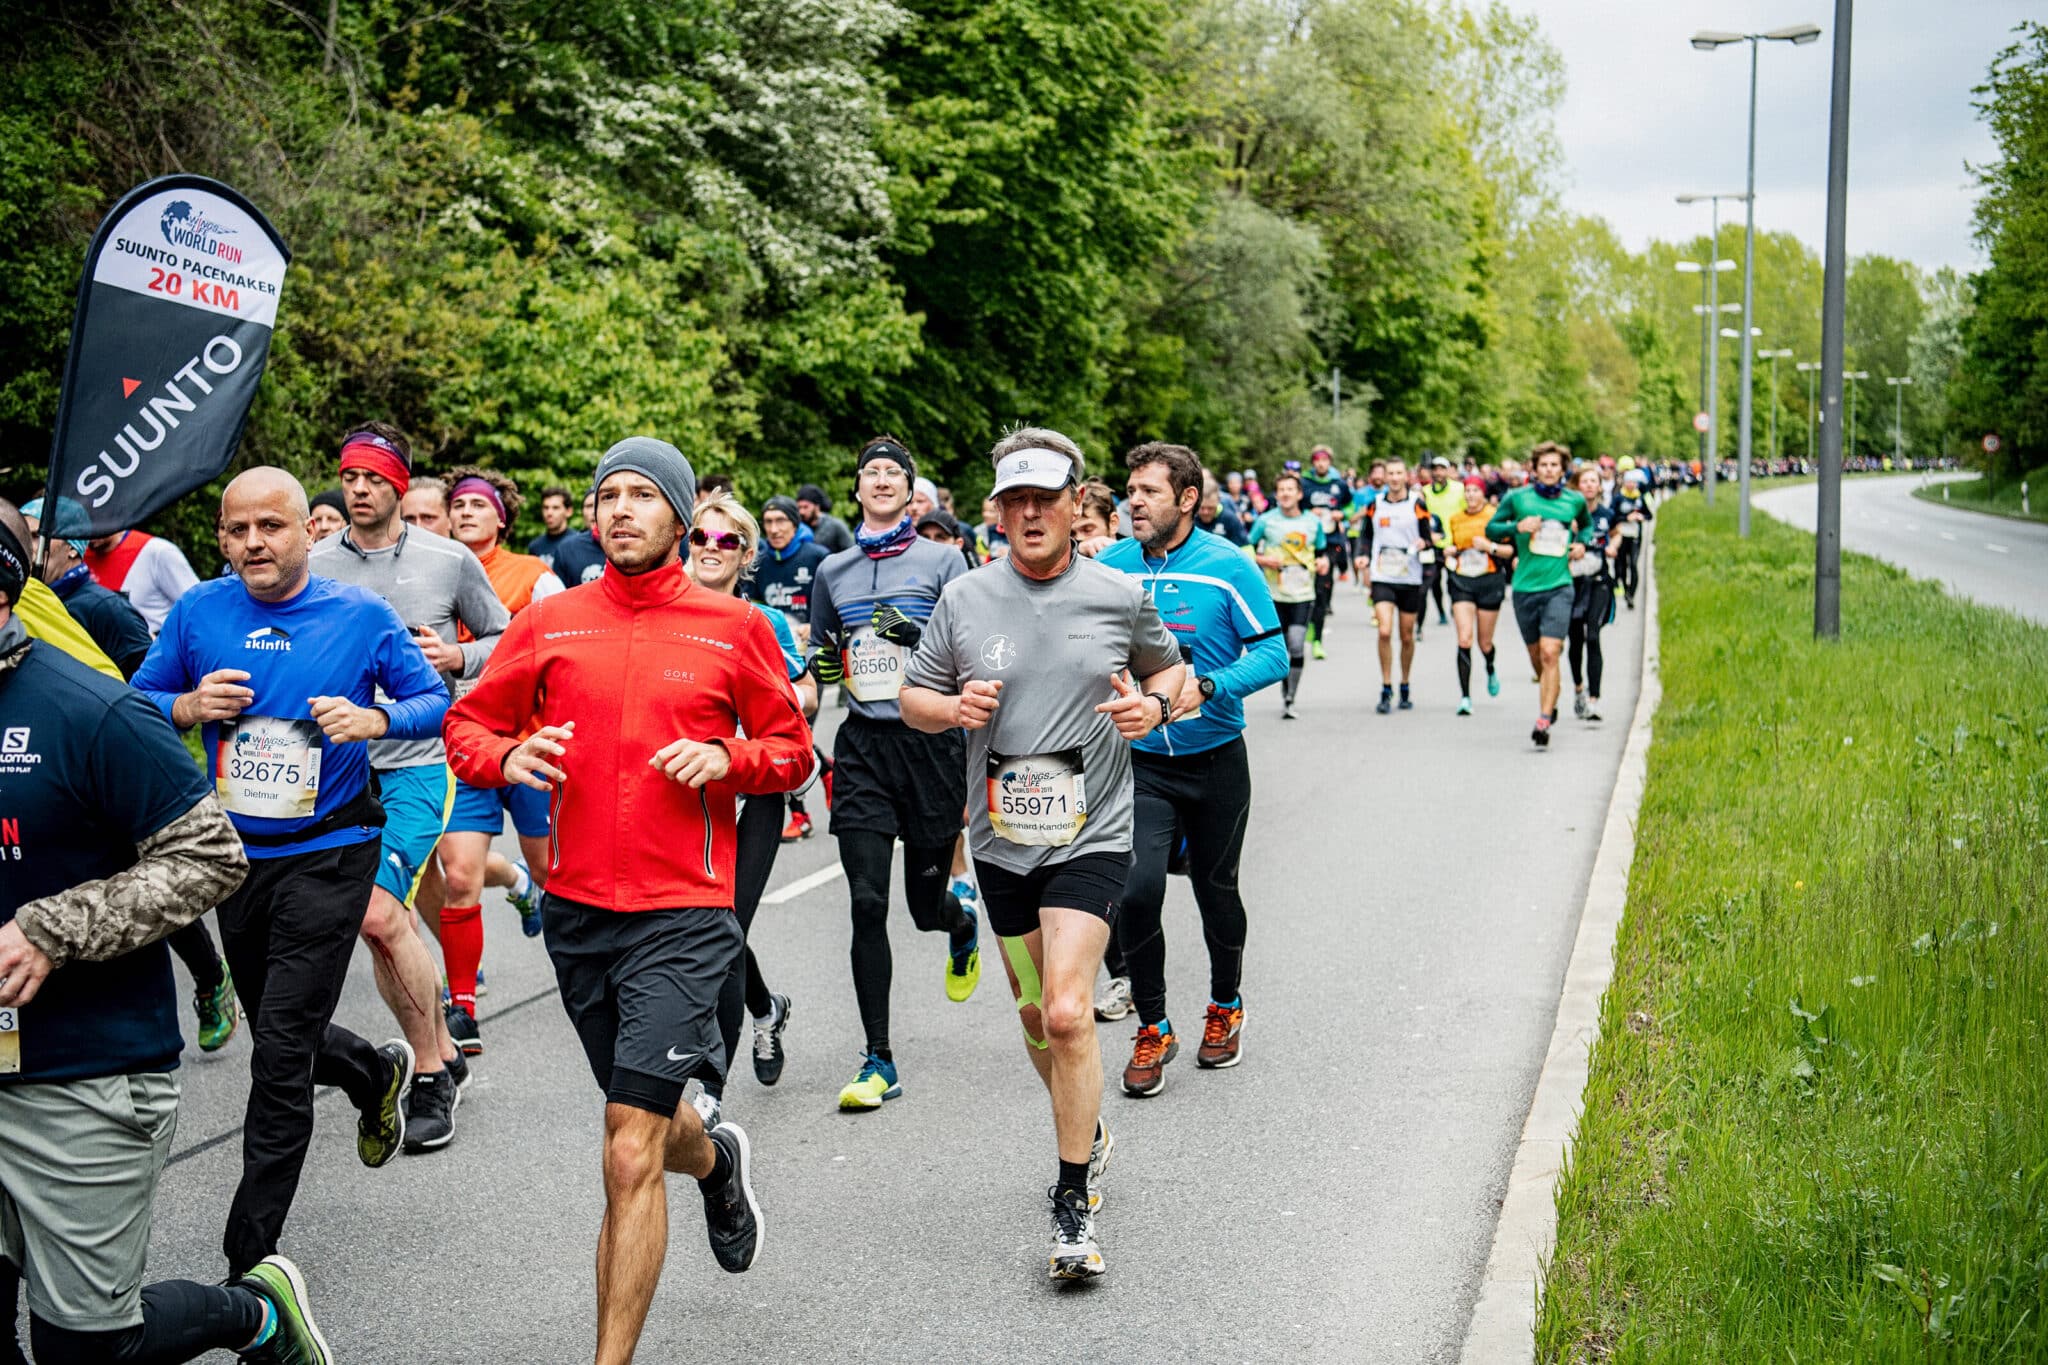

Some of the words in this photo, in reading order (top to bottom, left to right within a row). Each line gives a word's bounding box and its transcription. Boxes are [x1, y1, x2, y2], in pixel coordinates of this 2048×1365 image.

[116, 237, 178, 267] SUUNTO
[182, 258, 276, 296] PACEMAKER
[148, 267, 182, 296] 20
[192, 279, 239, 311] KM
[76, 335, 243, 509] SUUNTO
[245, 639, 291, 651] skinfit
[852, 656, 898, 676] 26560
[664, 669, 695, 681] GORE
[230, 758, 300, 785] 32675
[1018, 770, 1050, 781] WINGS
[306, 775, 316, 789] 4
[244, 788, 280, 801] Dietmar
[1002, 794, 1067, 816] 55971
[1075, 800, 1085, 814] 3
[1000, 818, 1038, 831] Bernhard
[1039, 820, 1077, 832] Kandera
[0, 1011, 14, 1031] 3
